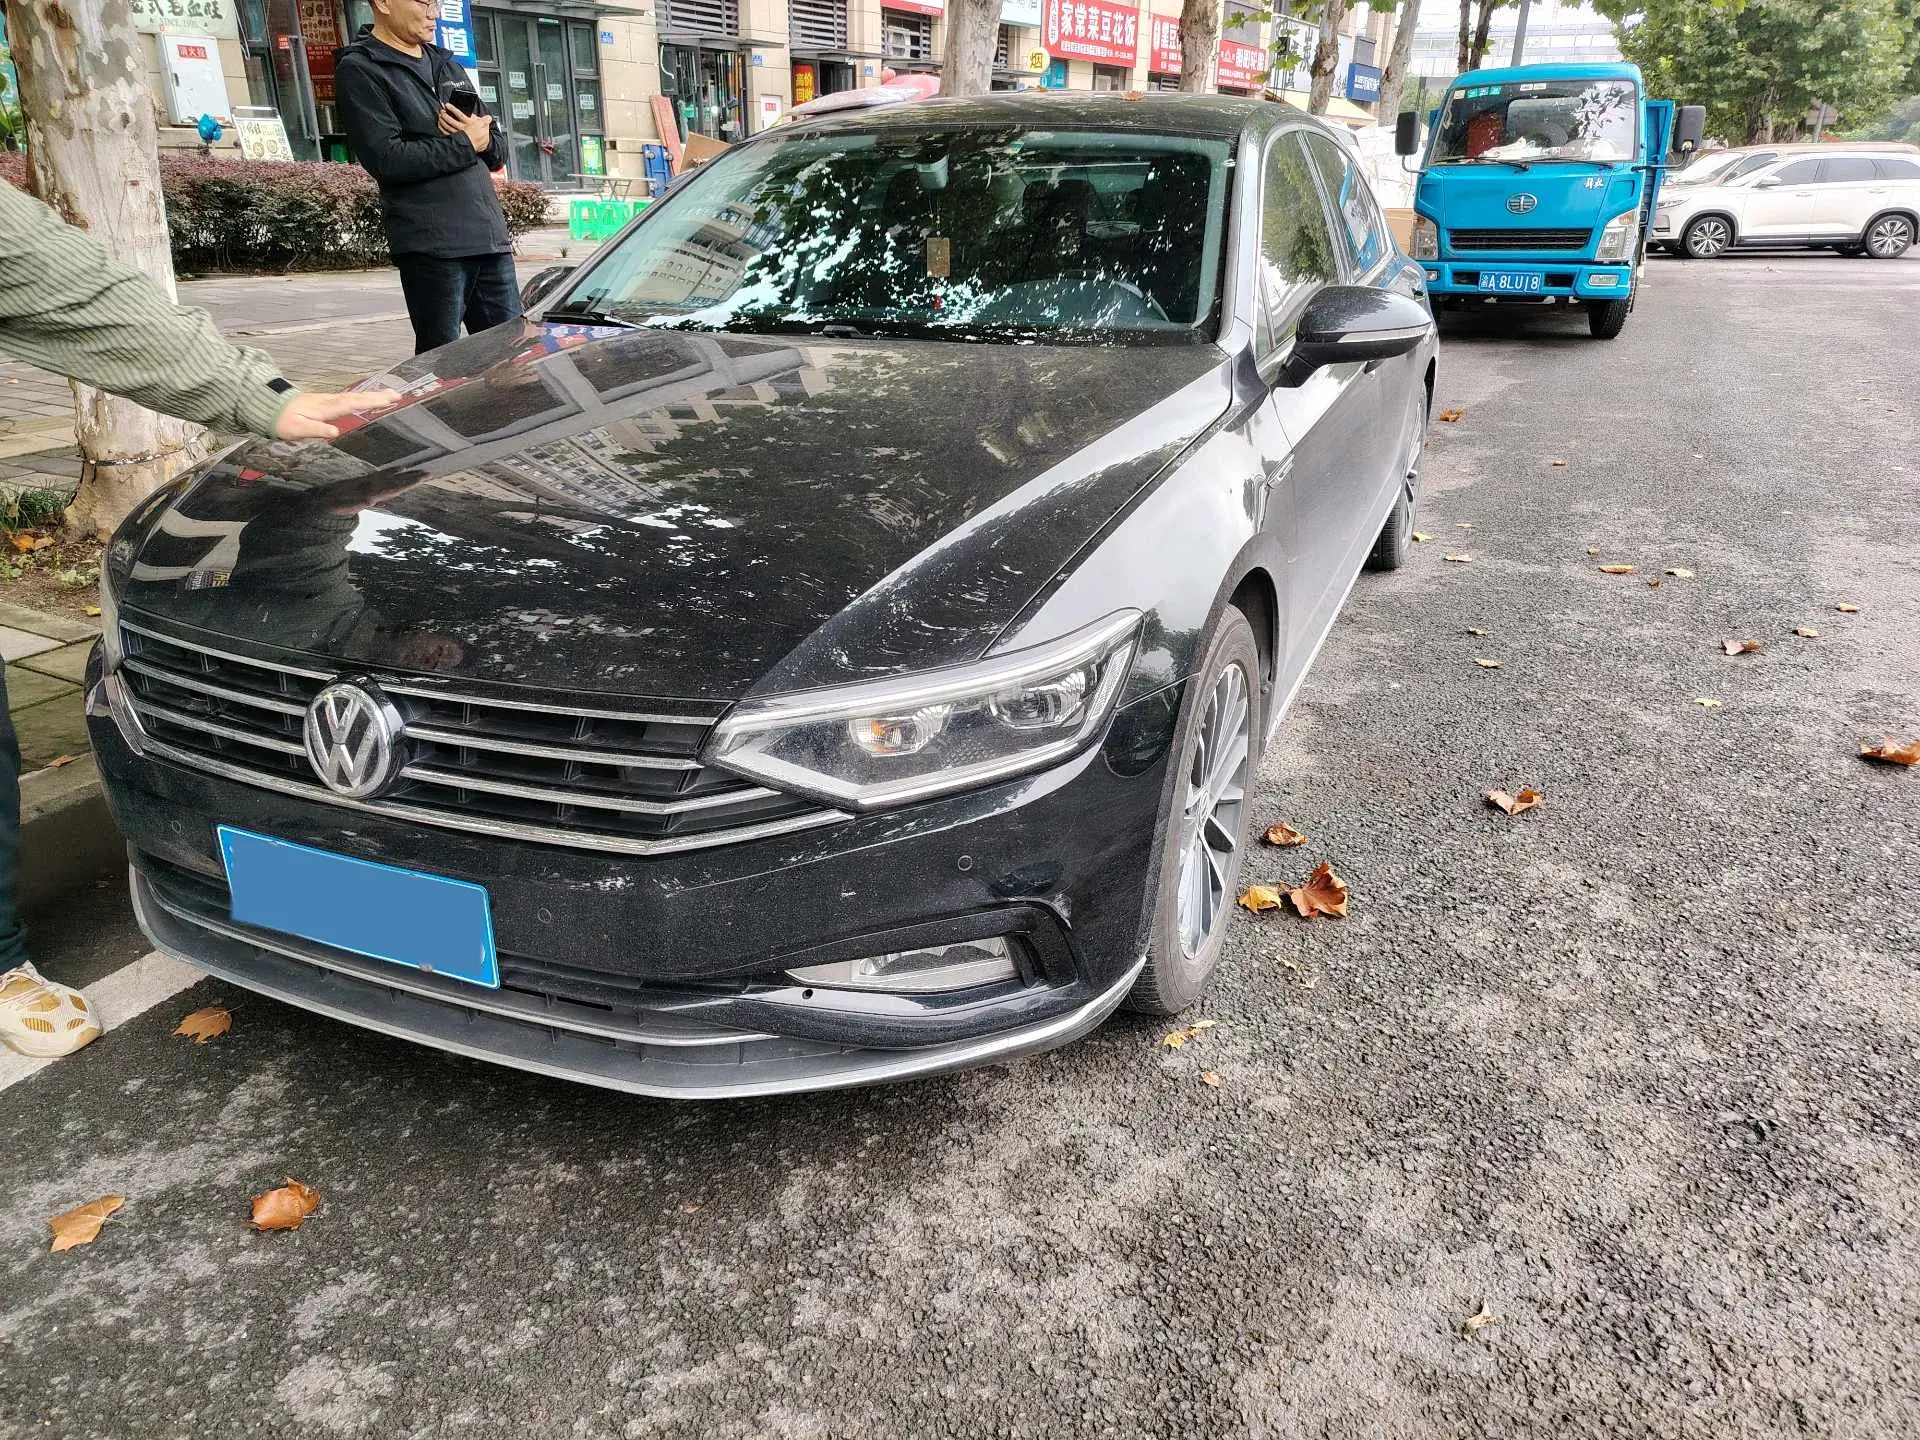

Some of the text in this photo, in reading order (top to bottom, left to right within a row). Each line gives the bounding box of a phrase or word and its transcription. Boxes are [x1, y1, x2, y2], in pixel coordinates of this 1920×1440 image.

[1061, 1, 1136, 47] 家常菜豆花饭
[1030, 52, 1044, 69] 烟
